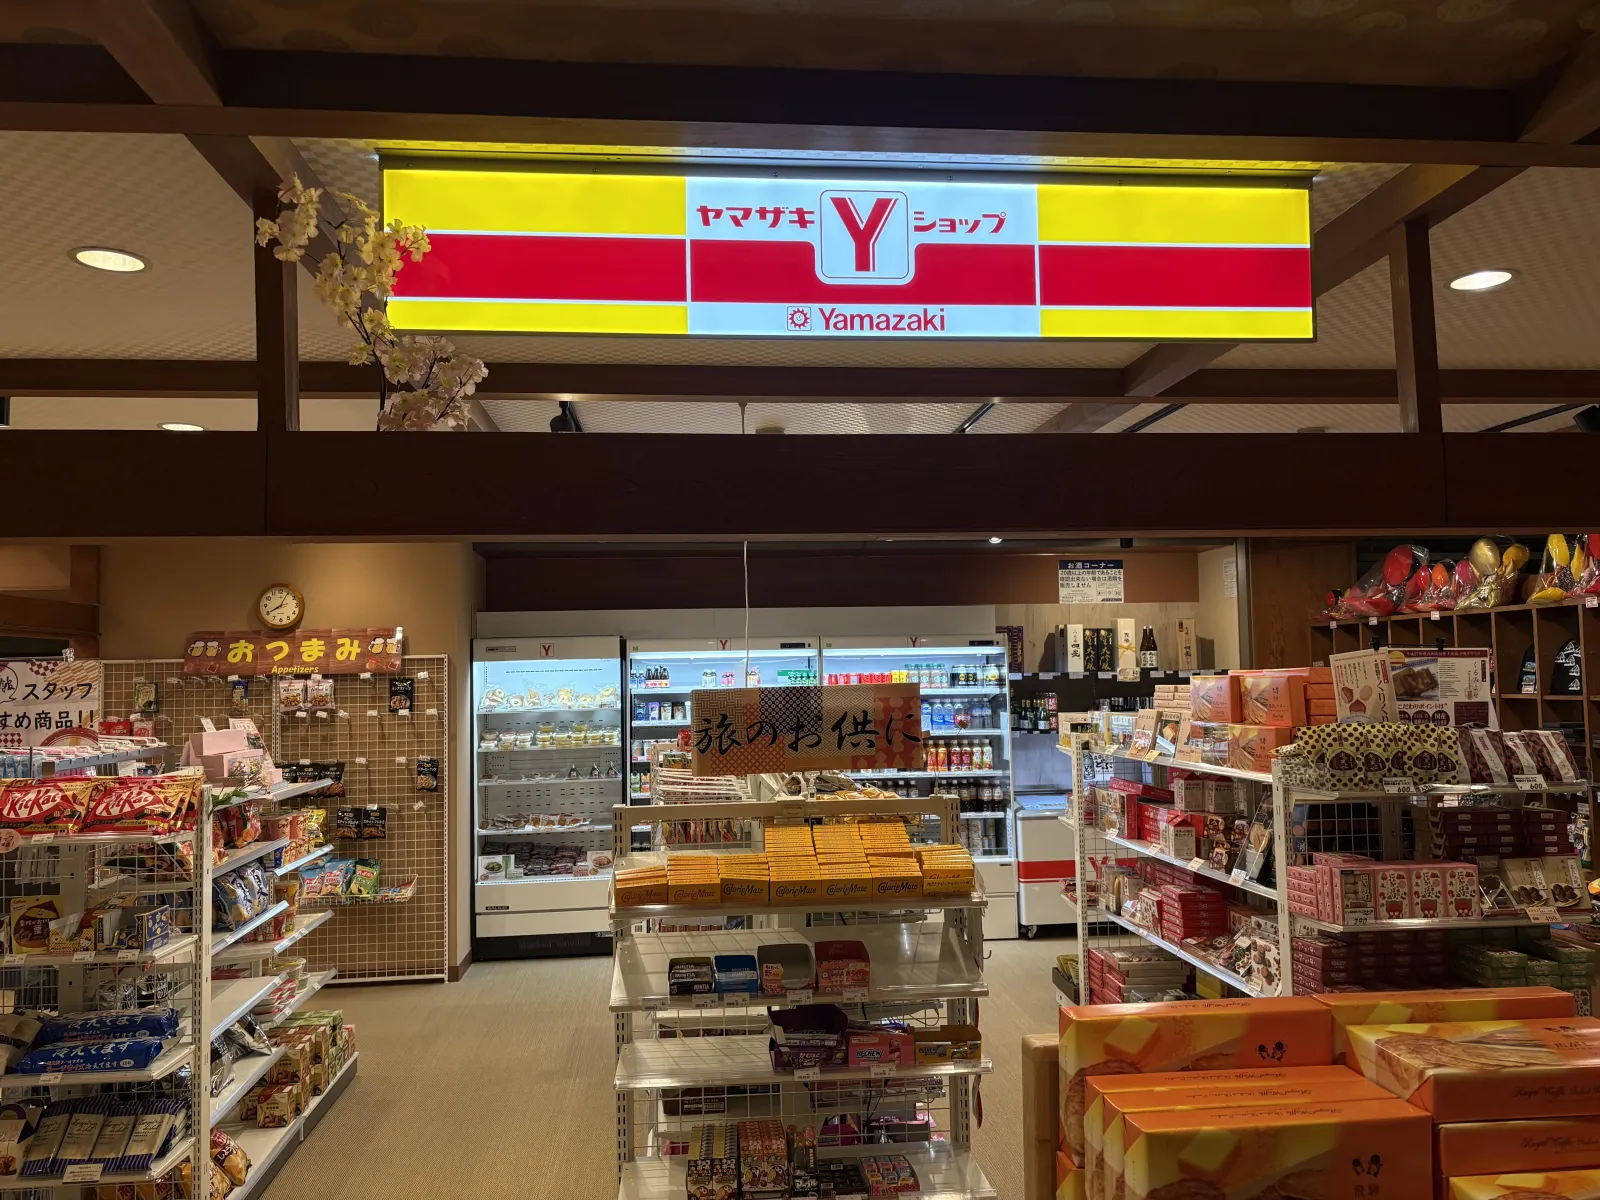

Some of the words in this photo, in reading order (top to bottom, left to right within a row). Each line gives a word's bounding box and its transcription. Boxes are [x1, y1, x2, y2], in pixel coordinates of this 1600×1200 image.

[697, 205, 815, 229] ヤマザキ
[913, 211, 1007, 234] ショップ
[829, 197, 898, 272] Y
[818, 308, 945, 331] Yamazaki
[227, 638, 361, 663] おつまみ
[542, 644, 552, 656] Y
[271, 665, 319, 674] Appetizers
[22, 683, 93, 700] スタッフ
[693, 710, 922, 756] 旅のお供に
[723, 884, 764, 895] CalorieMate
[776, 884, 816, 897] CalorieMate
[826, 884, 868, 896] CalorieMate
[878, 882, 918, 894] CalorieMate
[52, 1042, 134, 1058] 冷えてます
